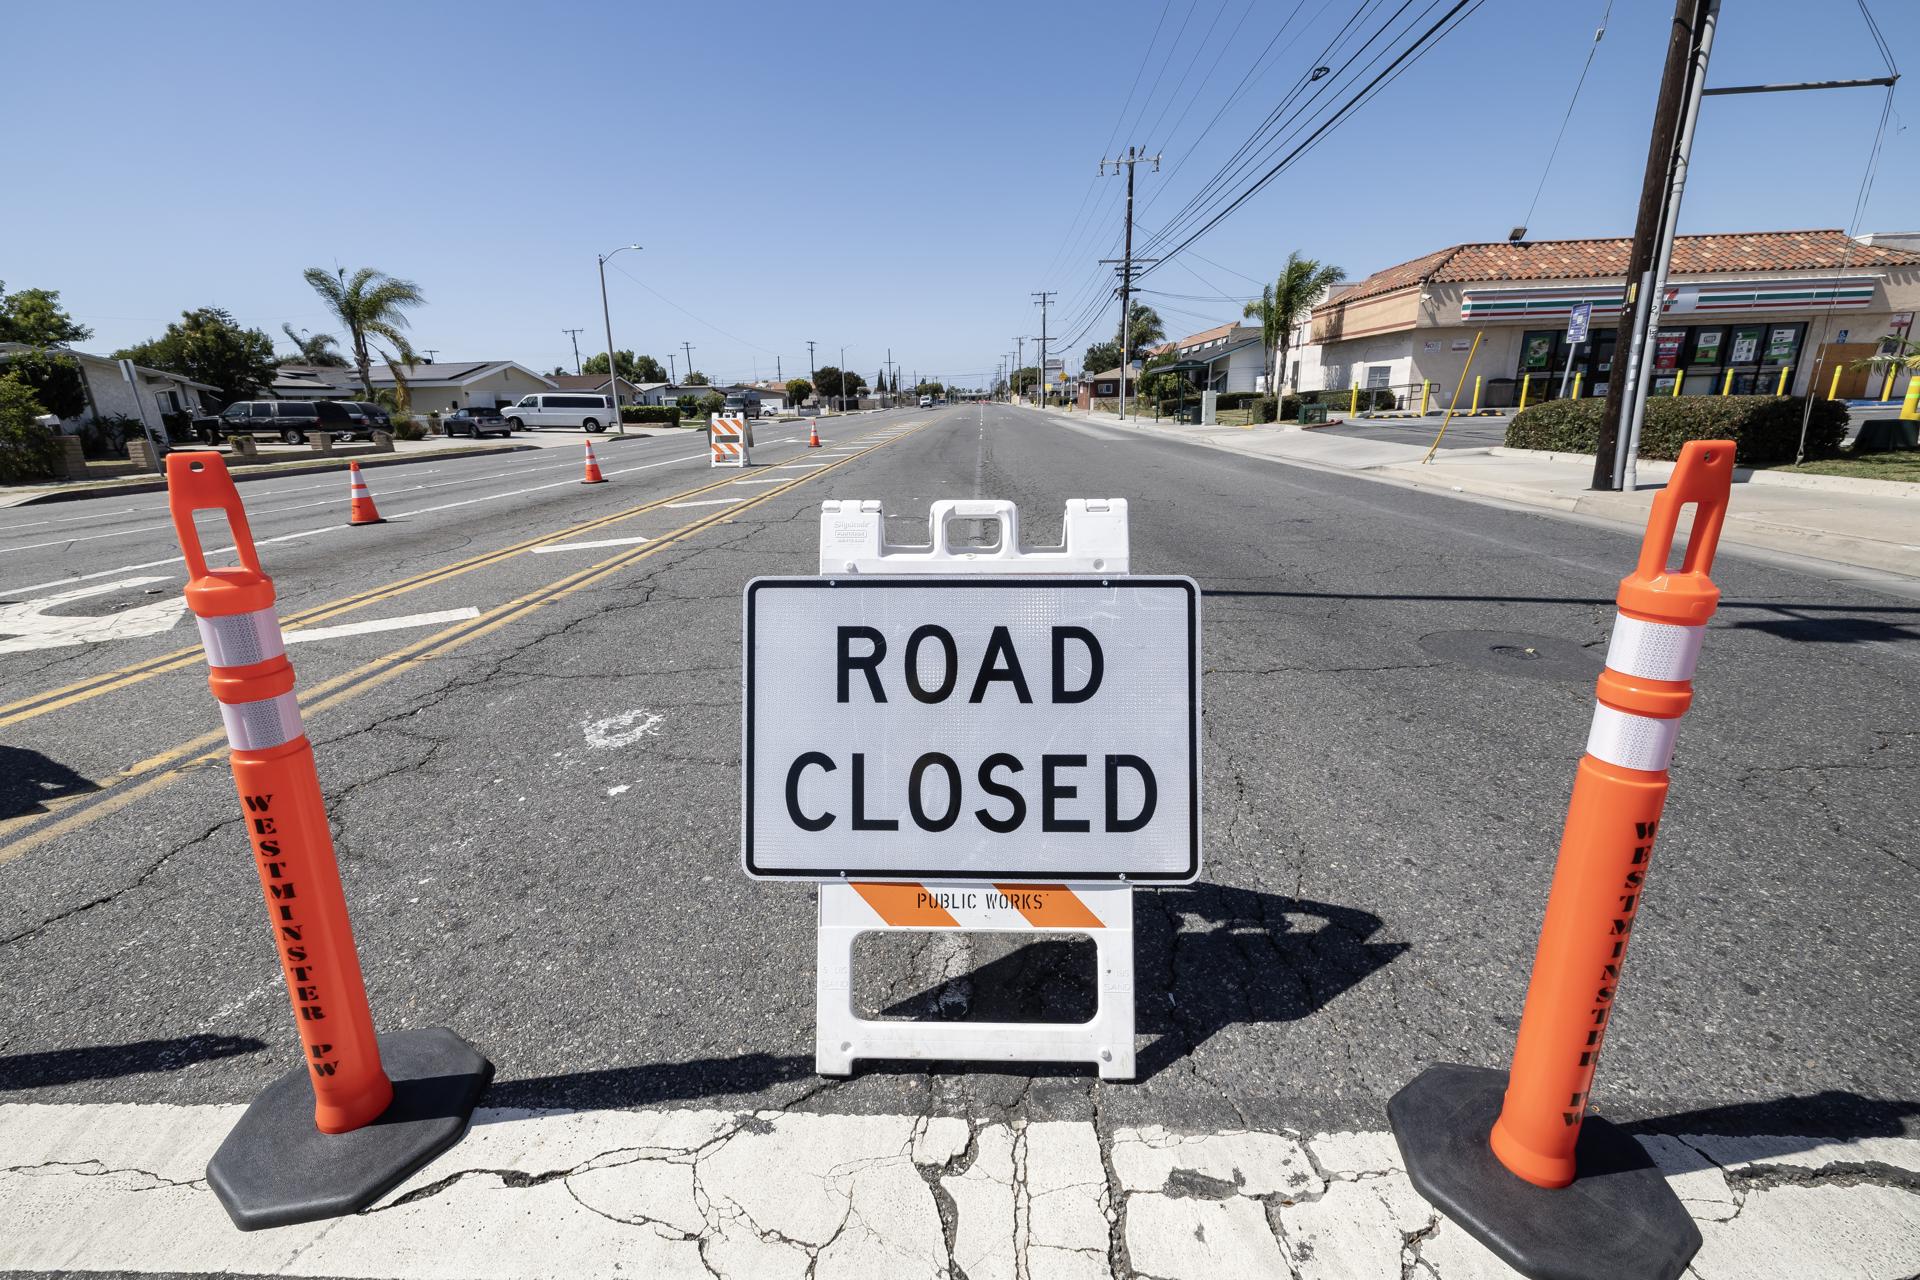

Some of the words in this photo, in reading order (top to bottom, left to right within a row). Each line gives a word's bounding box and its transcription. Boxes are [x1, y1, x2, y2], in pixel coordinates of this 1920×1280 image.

[836, 624, 1105, 704] ROAD
[785, 751, 1158, 834] CLOSED
[244, 794, 327, 1021] WESTMINSTER
[917, 893, 977, 910] PUBLIC
[986, 893, 1043, 910] WORKS
